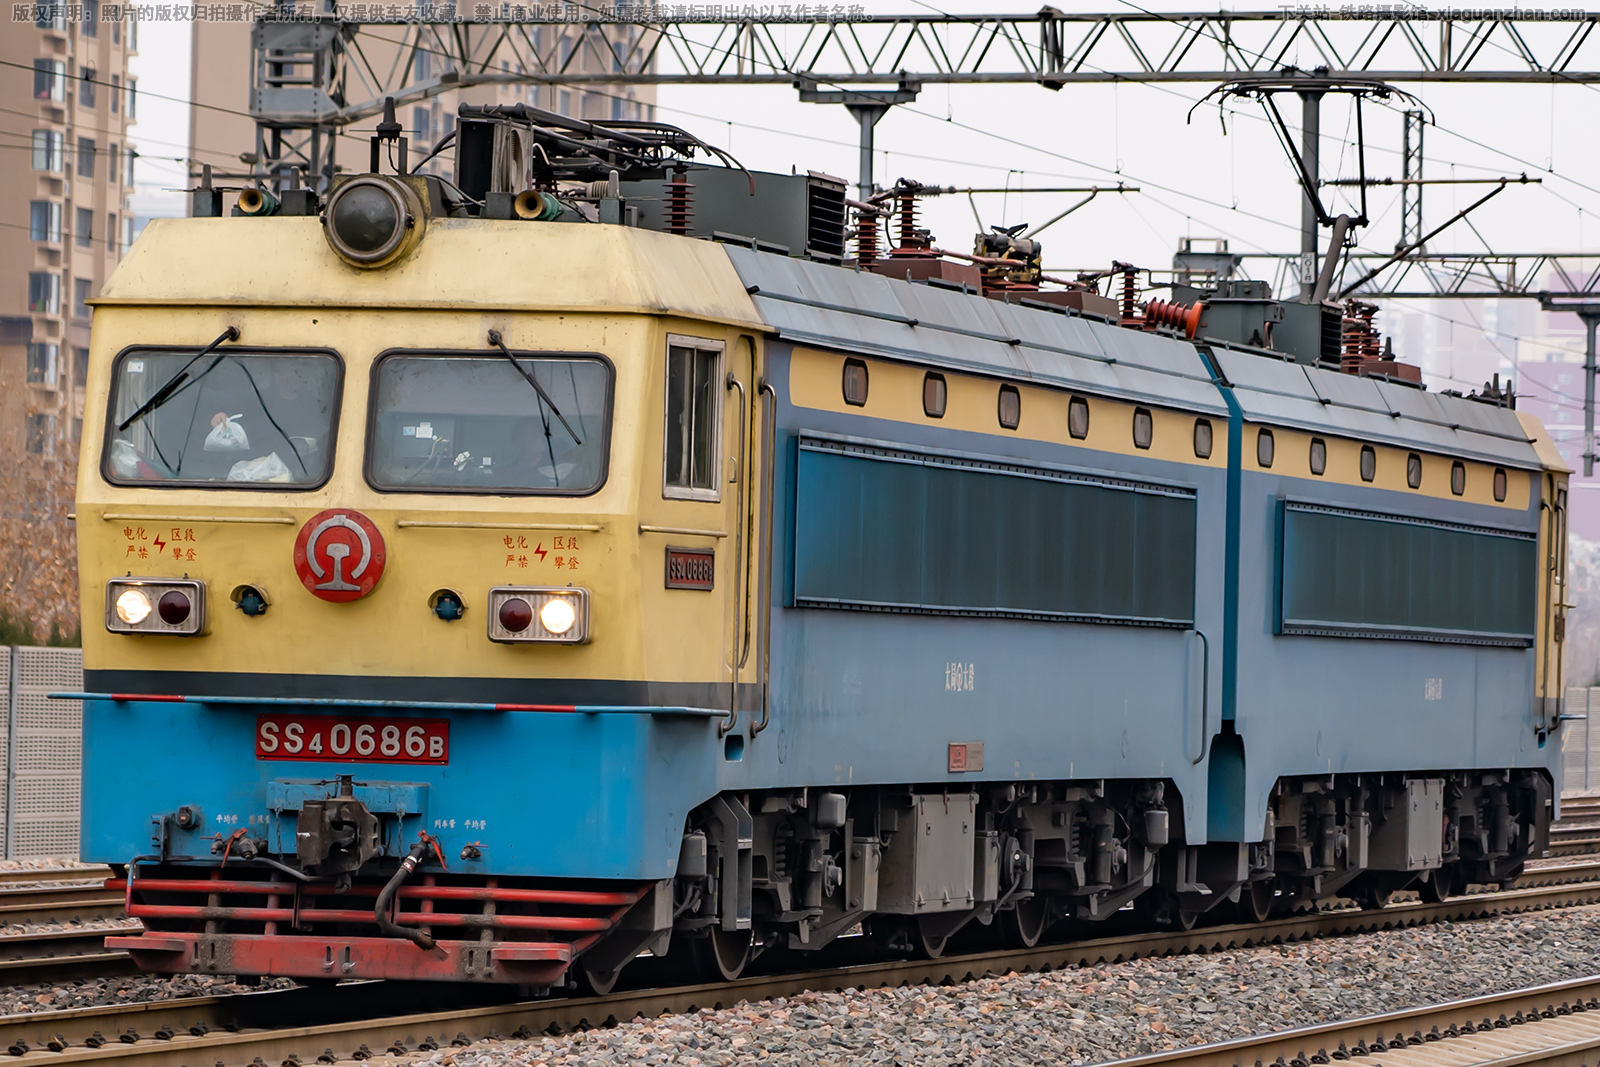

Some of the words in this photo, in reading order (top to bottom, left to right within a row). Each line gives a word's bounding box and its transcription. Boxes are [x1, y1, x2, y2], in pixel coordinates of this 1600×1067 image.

[123, 526, 148, 541] 电化
[170, 527, 196, 542] 区段
[503, 535, 529, 549] 电化
[553, 536, 579, 551] 区段
[125, 545, 149, 560] 严禁
[172, 547, 197, 562] 攀登
[504, 554, 529, 569] 严禁
[553, 556, 580, 570] 攀登
[259, 721, 444, 758] SS40686B
